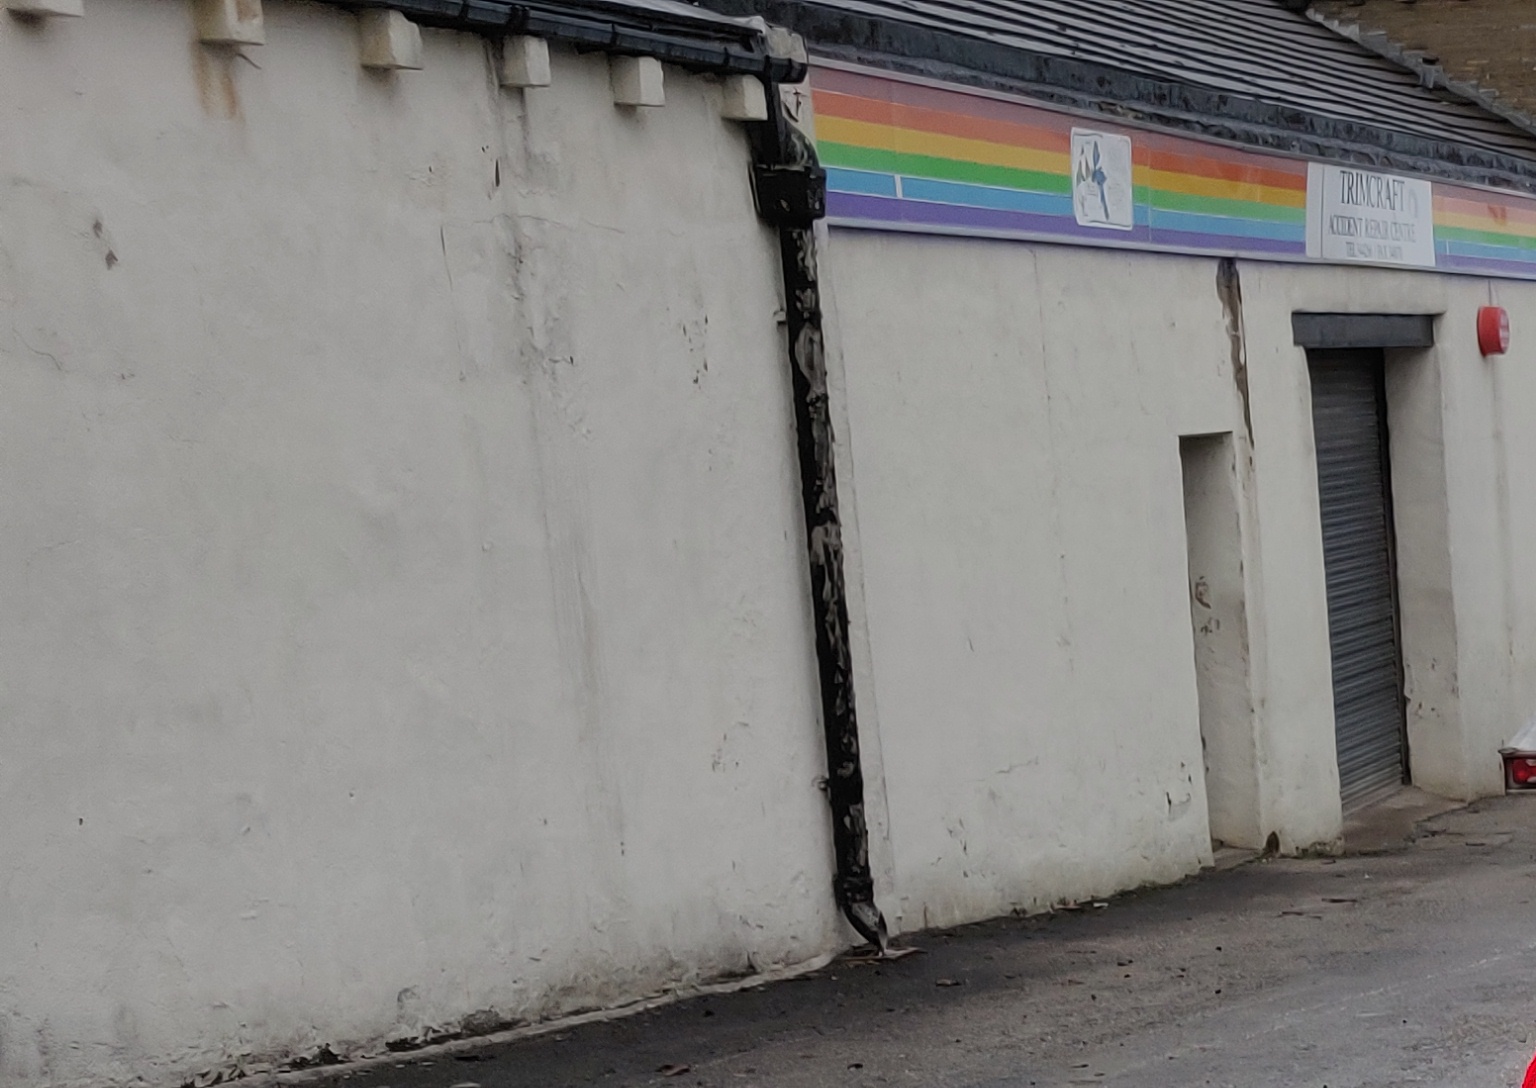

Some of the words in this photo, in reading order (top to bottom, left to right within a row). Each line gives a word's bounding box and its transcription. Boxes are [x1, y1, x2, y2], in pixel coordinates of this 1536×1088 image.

[1340, 170, 1405, 212] TRIMCRAFT
[1329, 214, 1363, 237] ACCIDENT
[1365, 219, 1389, 240] REPAIR
[1390, 222, 1416, 242] CENTRE
